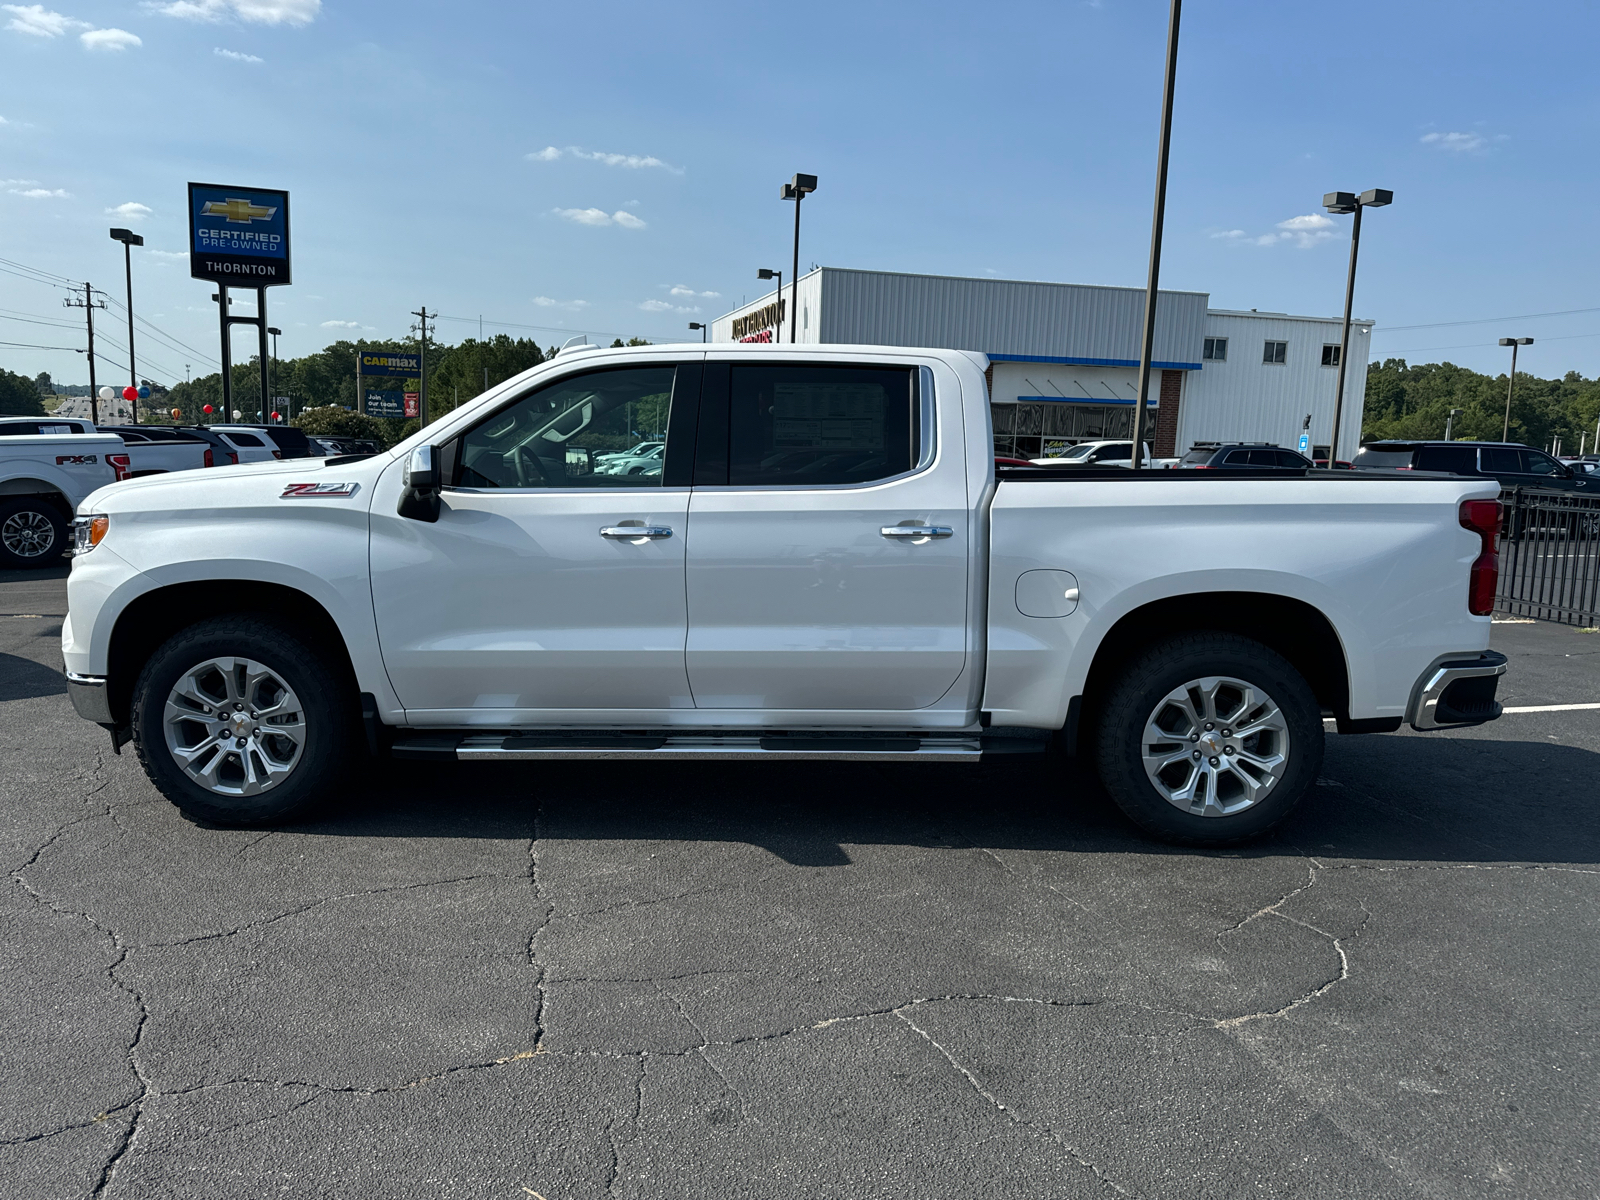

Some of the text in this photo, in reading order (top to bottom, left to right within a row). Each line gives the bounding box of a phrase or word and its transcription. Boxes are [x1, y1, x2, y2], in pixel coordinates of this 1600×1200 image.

[198, 228, 281, 243] CERTIFIED
[202, 238, 277, 251] PRE-OWNED
[205, 261, 276, 276] THORNTON
[56, 455, 97, 465] FX4
[281, 482, 360, 498] Z71
